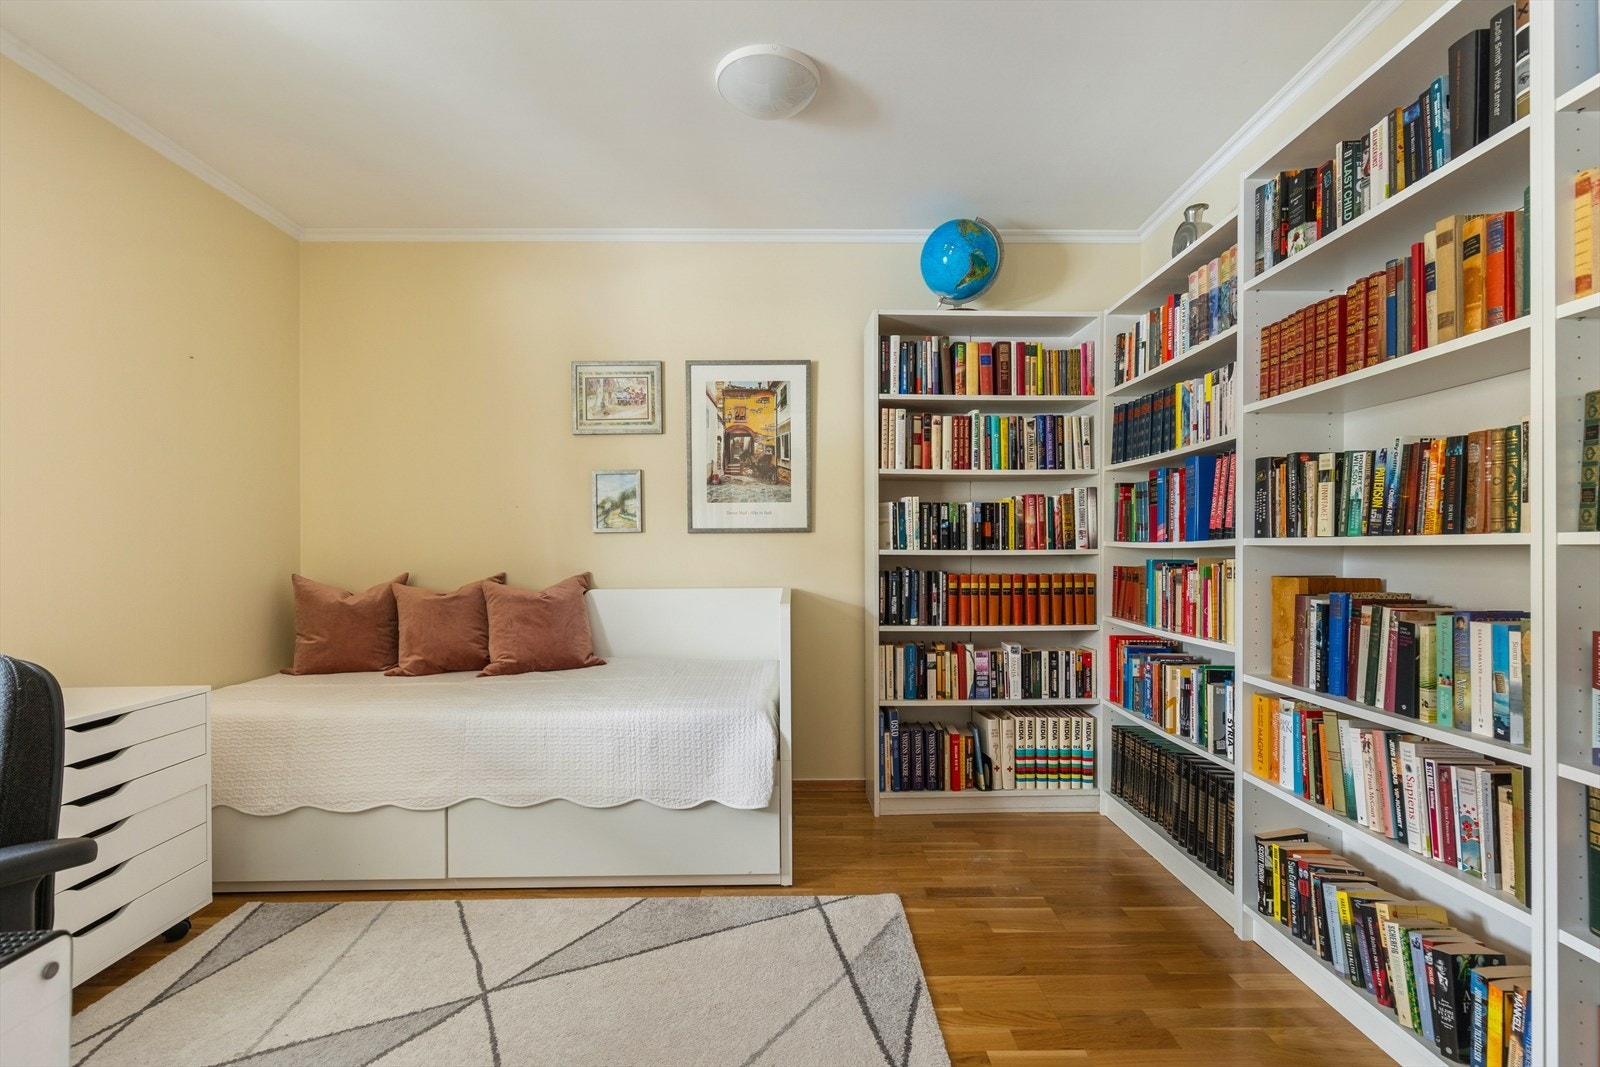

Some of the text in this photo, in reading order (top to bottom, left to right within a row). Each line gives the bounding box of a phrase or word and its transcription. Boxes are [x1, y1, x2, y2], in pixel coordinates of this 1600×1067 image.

[1493, 18, 1502, 116] Zadie Smith Hvite tenner
[1344, 162, 1352, 221] LAST CHILD
[1390, 451, 1398, 481] Griffiths
[1320, 484, 1329, 522] UNNTAKET
[1372, 467, 1386, 508] PATTERSON
[1385, 509, 1394, 526] PLACES
[1510, 665, 1519, 679] juni
[890, 719, 899, 737] OSLO
[1390, 757, 1398, 785] LAPIDUS
[1394, 788, 1403, 828] VIP-ROMMET
[1404, 775, 1417, 820] Sapiens
[1288, 874, 1297, 899] Grafton
[1340, 898, 1348, 915] HARLAN
[1388, 925, 1399, 955] SCHERFIG
[1474, 987, 1483, 1062] JOHN GRISHAM TILSTÅELSEN
[1512, 992, 1523, 1033] MANKELL
